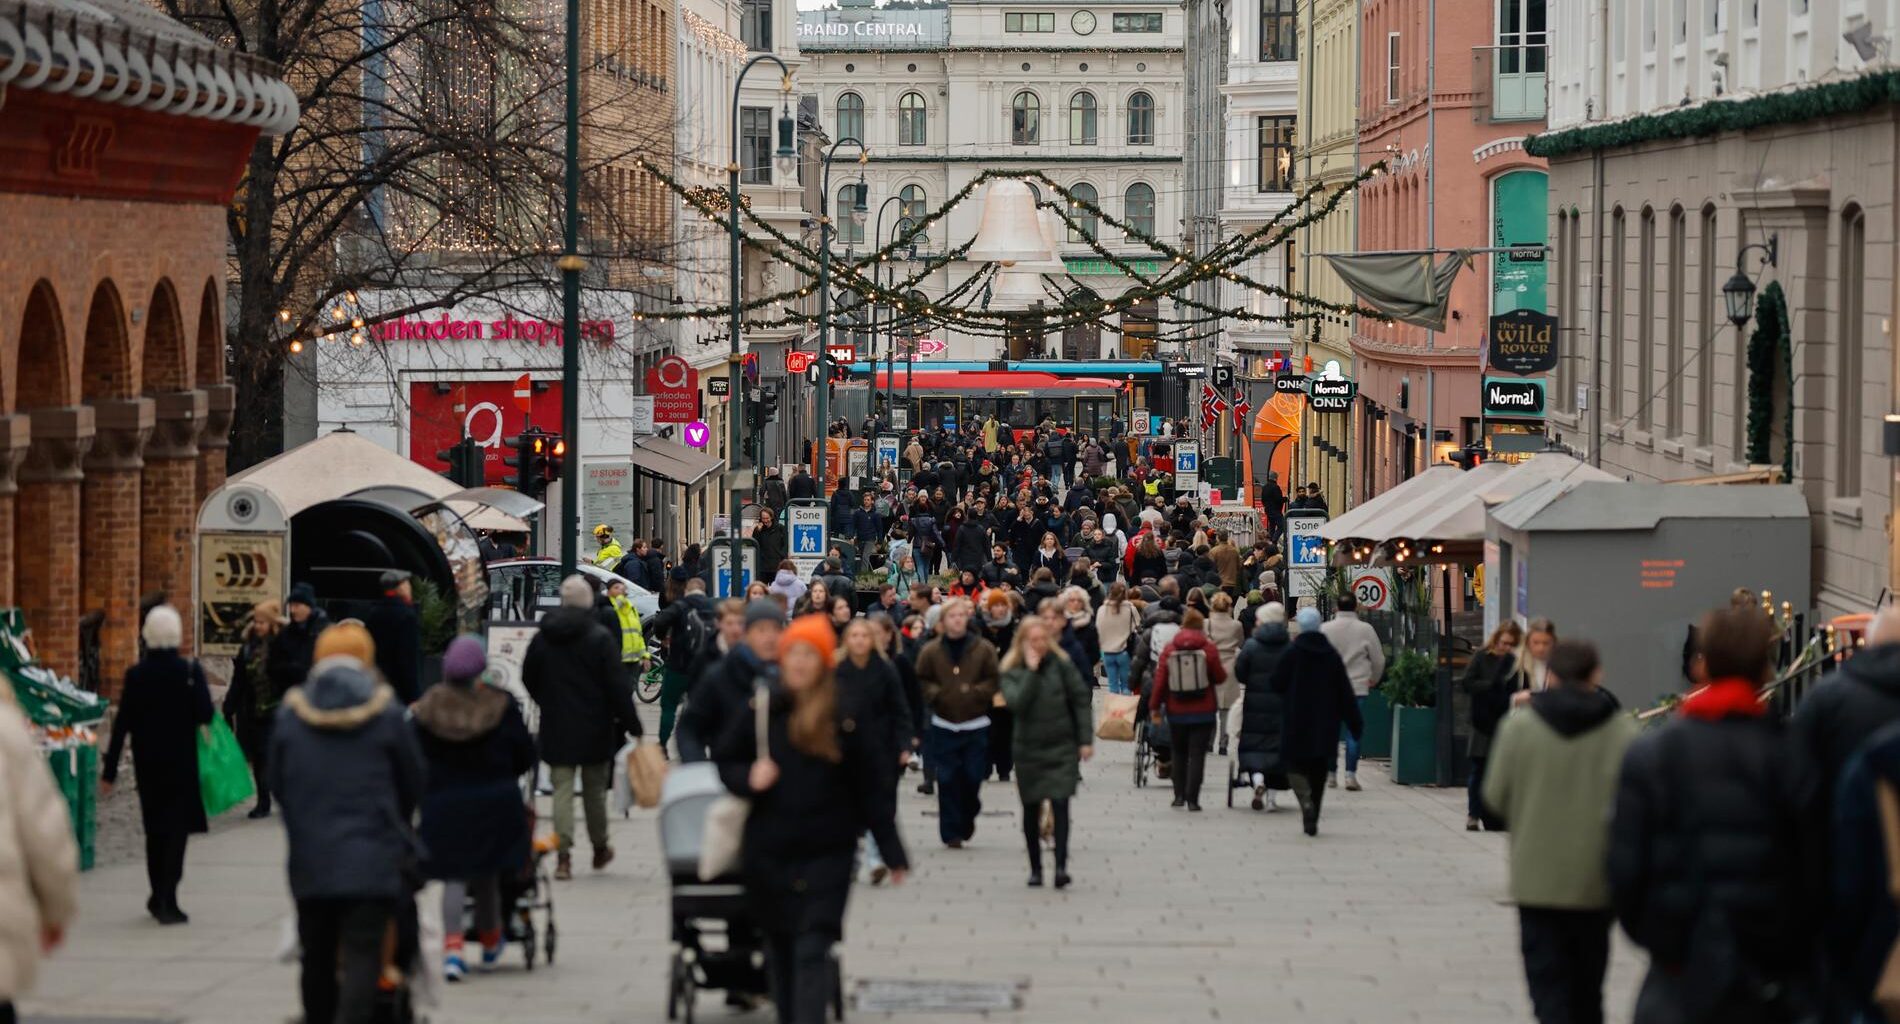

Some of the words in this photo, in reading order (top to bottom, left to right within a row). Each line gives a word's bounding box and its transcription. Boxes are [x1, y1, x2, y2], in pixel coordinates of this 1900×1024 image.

[854, 21, 925, 36] CENTRAL
[371, 313, 483, 341] arkaden
[790, 355, 804, 369] deli
[1314, 383, 1349, 395] Normal
[1490, 386, 1534, 405] Normal
[1313, 398, 1348, 408] ONLY
[1137, 420, 1146, 429] 30
[795, 510, 820, 520] Sone
[1294, 520, 1319, 530] Sone
[1358, 585, 1381, 602] 30
